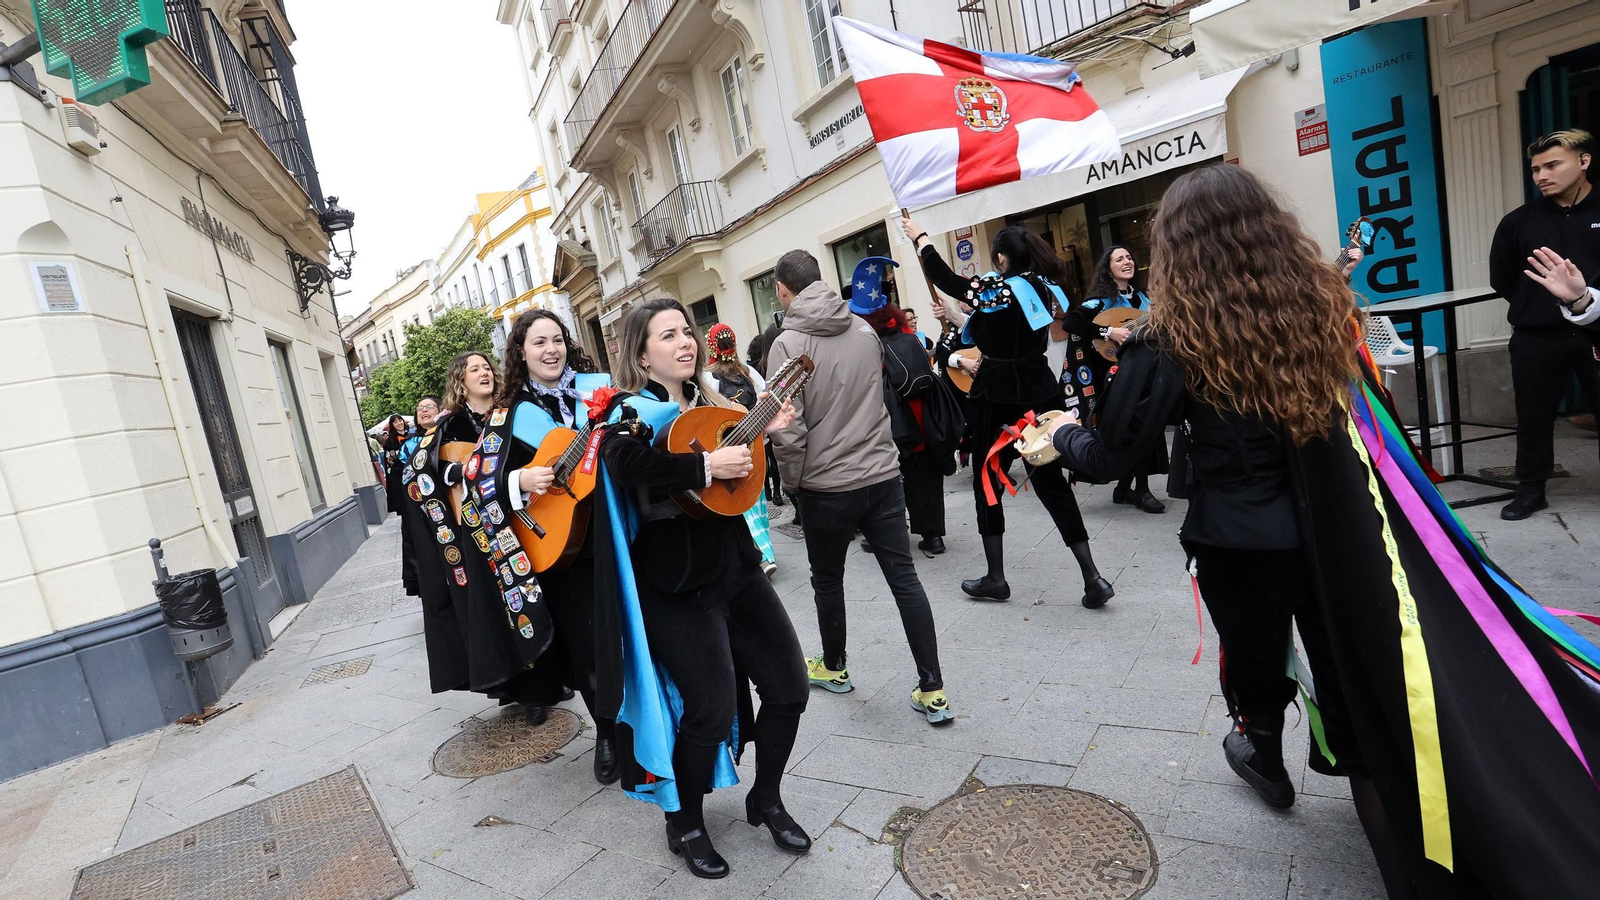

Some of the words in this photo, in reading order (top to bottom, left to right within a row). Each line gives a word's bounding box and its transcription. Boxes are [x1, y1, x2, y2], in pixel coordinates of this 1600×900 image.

[1333, 51, 1414, 84] RESTAURANTE
[809, 104, 865, 150] CONSISTORIO
[1299, 125, 1326, 137] Alarma
[1086, 131, 1206, 184] AMANCIA
[499, 532, 514, 545] TUNA
